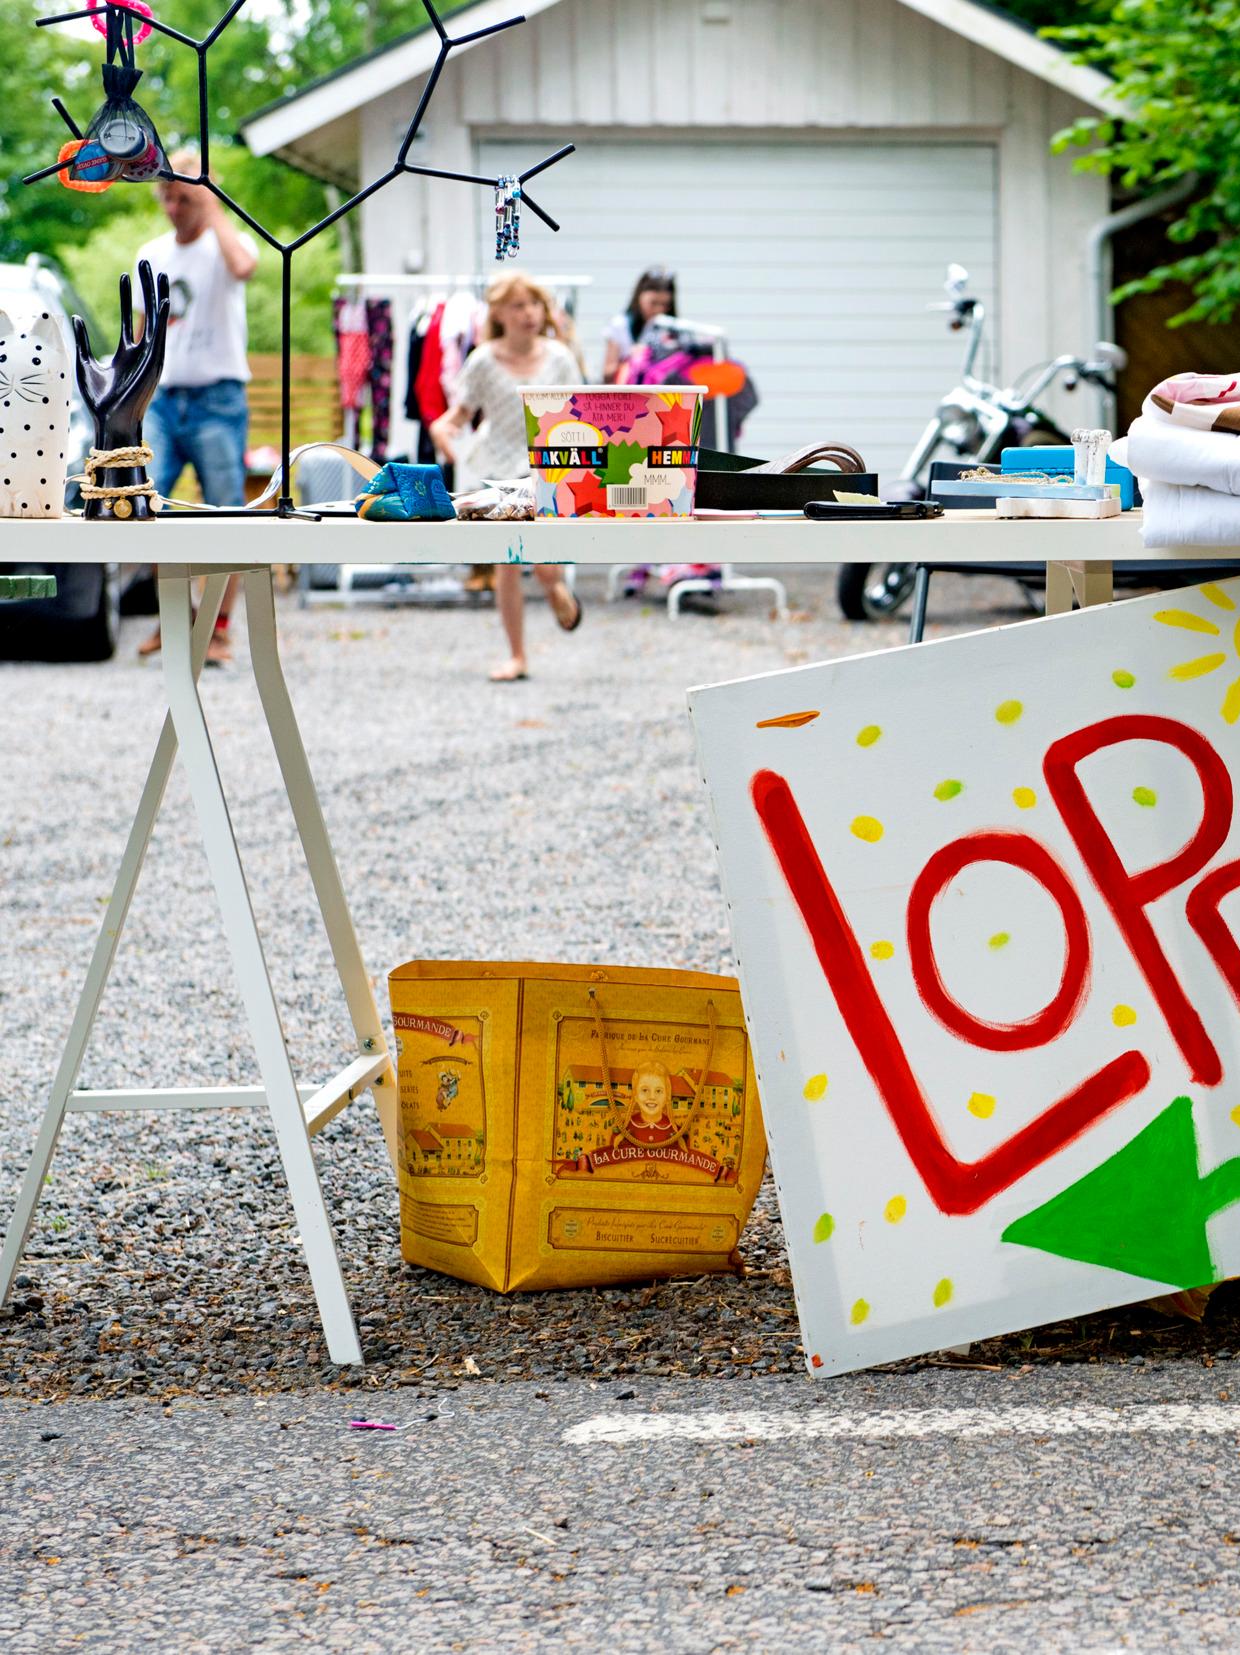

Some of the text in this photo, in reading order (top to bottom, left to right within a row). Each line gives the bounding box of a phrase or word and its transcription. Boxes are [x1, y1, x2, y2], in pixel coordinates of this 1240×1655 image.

[623, 403, 635, 411] DU
[591, 1029, 625, 1041] FARIQUE
[612, 1147, 645, 1161] CURE
[646, 1148, 718, 1173] GOURMANDE
